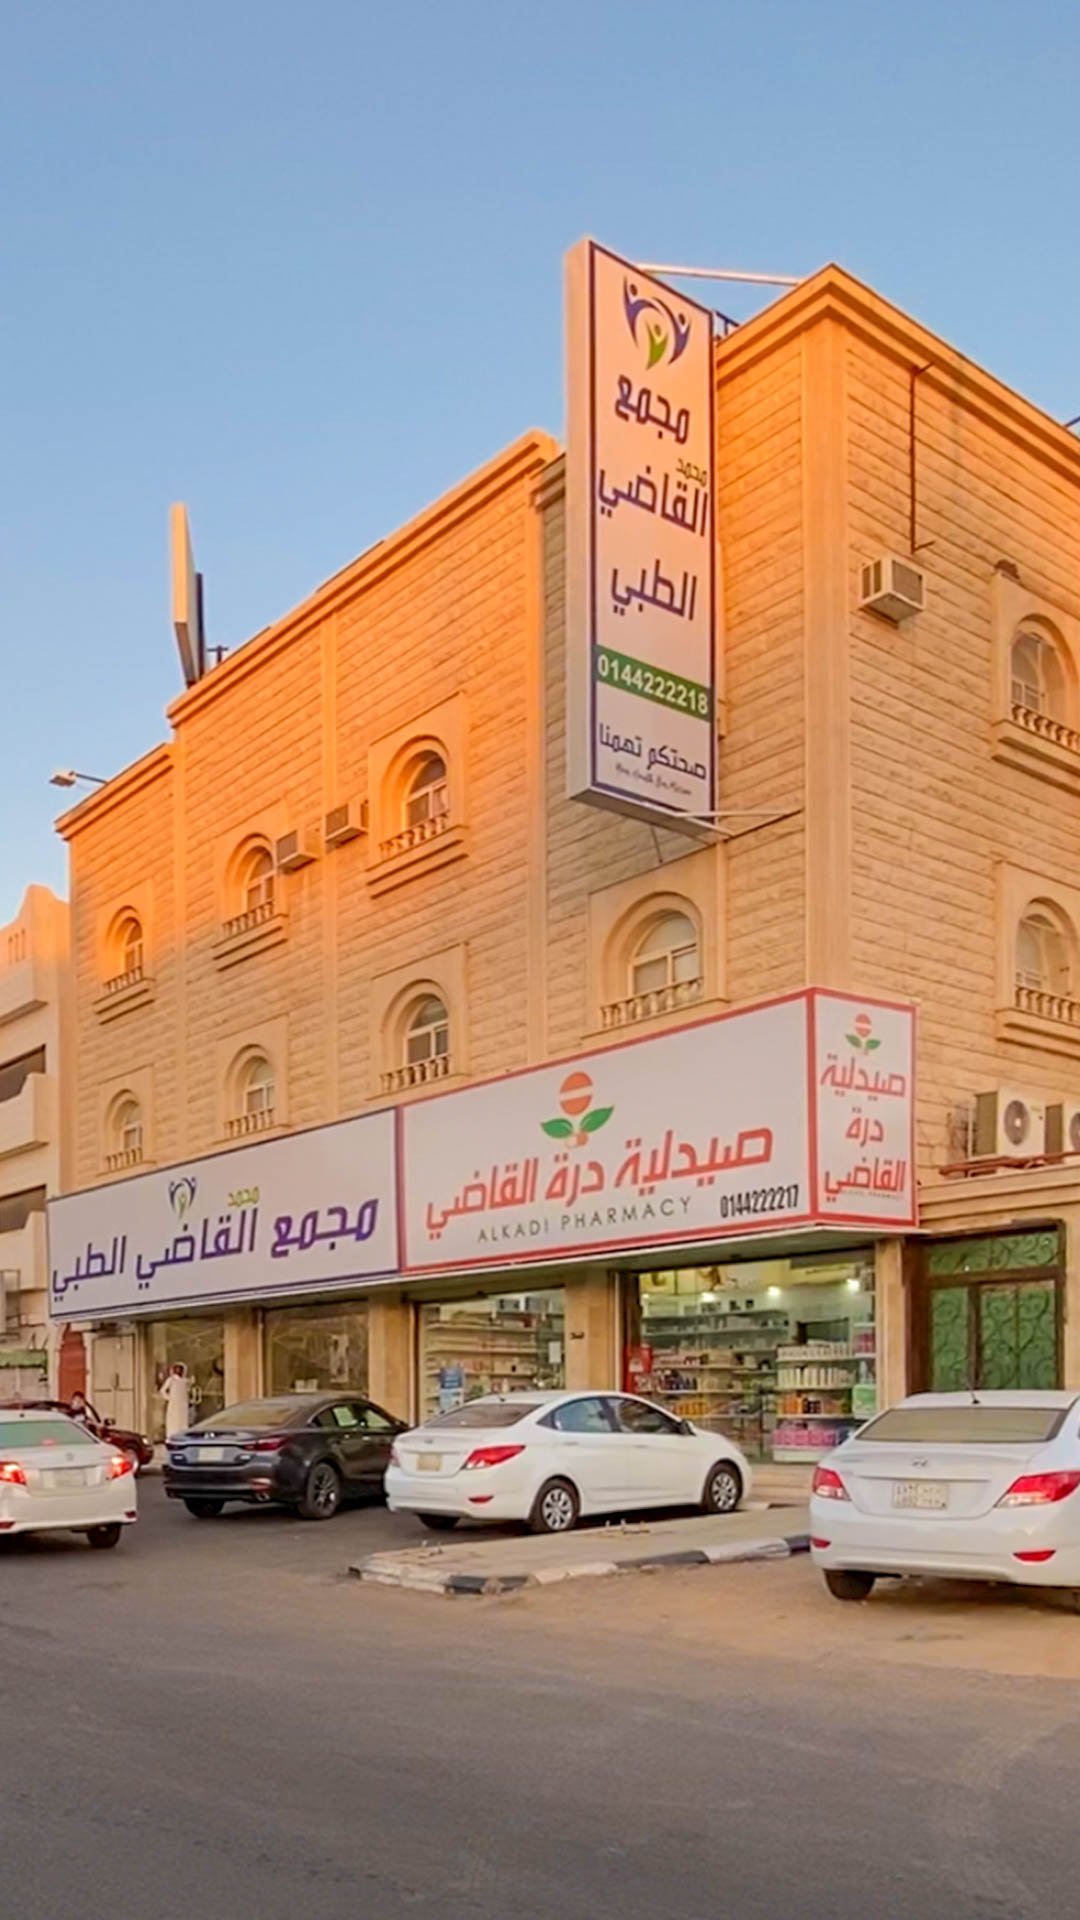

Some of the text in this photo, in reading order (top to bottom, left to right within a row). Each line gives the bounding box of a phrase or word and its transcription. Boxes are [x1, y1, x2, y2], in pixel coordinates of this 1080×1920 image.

[615, 374, 690, 444] مجمع
[676, 458, 708, 487] محمد
[598, 465, 709, 536] القاضي
[611, 558, 697, 621] الطبي
[597, 654, 709, 715] 0144222218
[600, 723, 642, 758] تهمنا
[646, 745, 706, 780] صحتكم
[820, 1053, 906, 1101] صيدلية
[846, 1107, 884, 1148] درة
[228, 1187, 259, 1207] محمد
[426, 1126, 773, 1240] صيدلية درة القاضي
[719, 1184, 800, 1219] 0144222217
[825, 1157, 906, 1202] القاضي
[477, 1196, 692, 1243] ALKADI PHARMACY
[52, 1199, 379, 1302] مجمع القاضي الطبي
